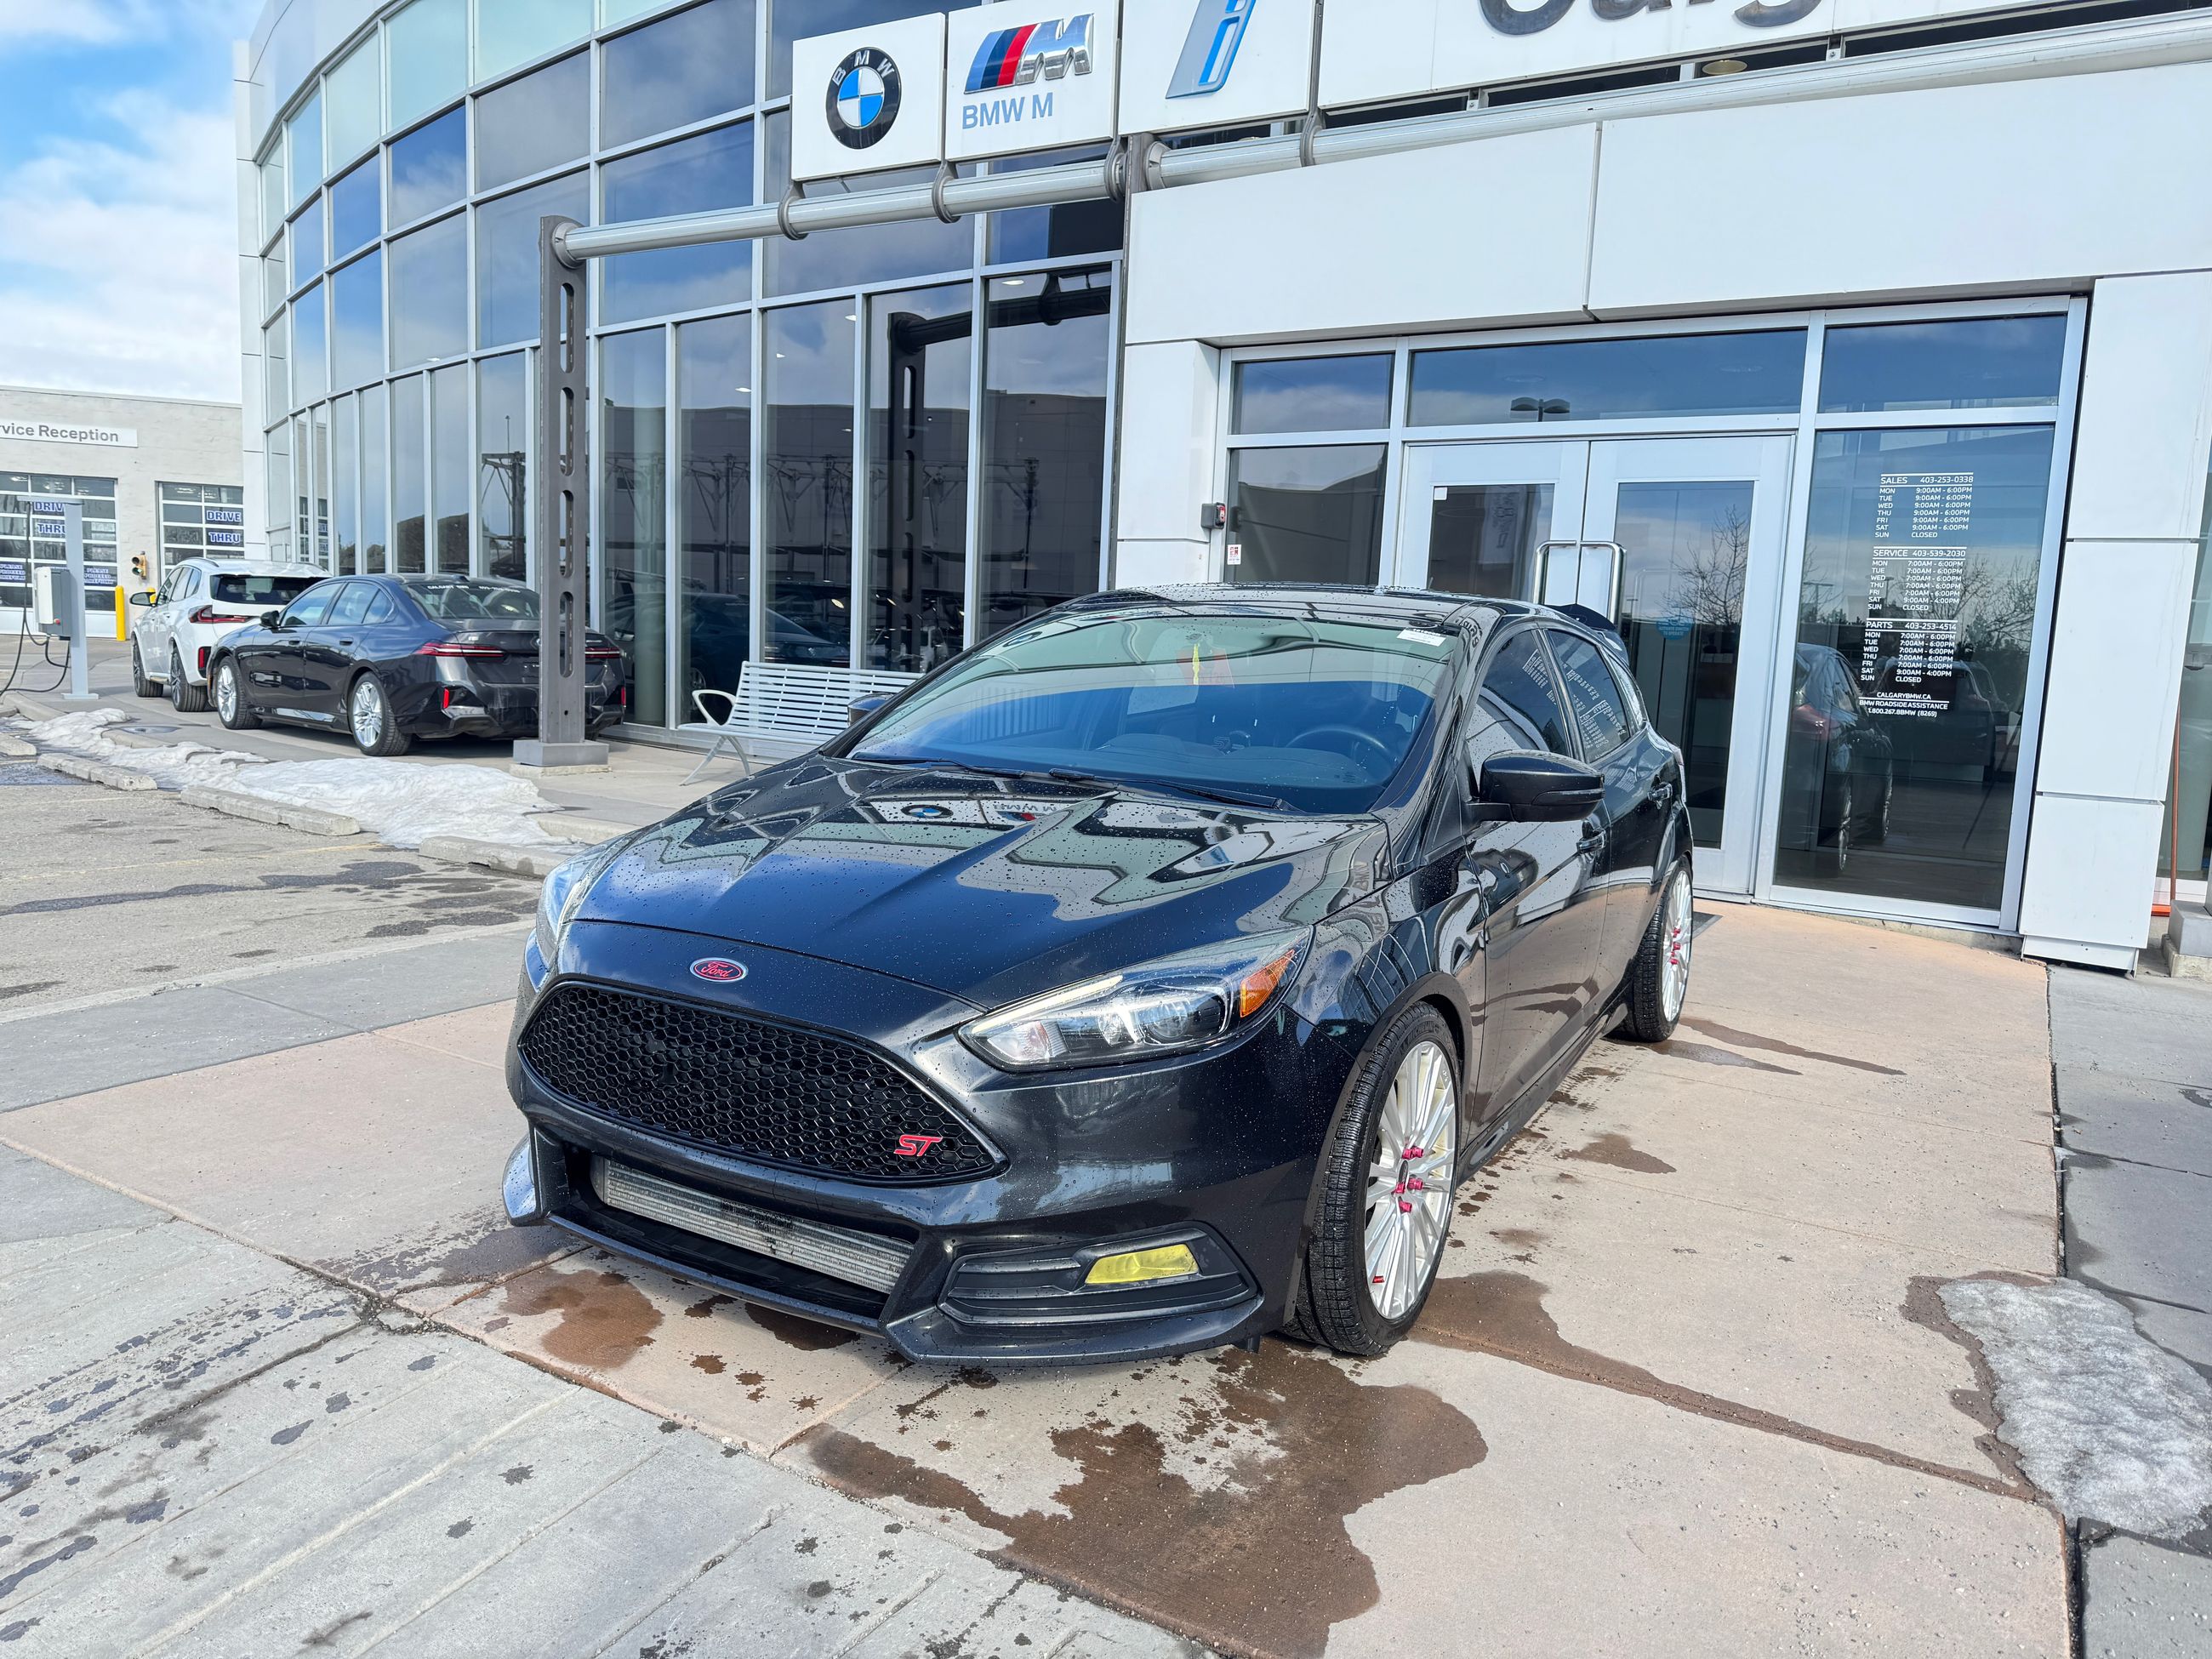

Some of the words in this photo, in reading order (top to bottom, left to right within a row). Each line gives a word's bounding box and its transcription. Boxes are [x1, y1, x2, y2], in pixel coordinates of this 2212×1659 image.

[831, 50, 894, 85] BMW
[961, 95, 1025, 129] BMW
[1031, 92, 1053, 119] M
[38, 425, 119, 442] Reception
[33, 502, 65, 511] DRIV
[207, 510, 242, 522] DRIVE
[208, 532, 241, 543] THRU
[1876, 692, 1931, 700] CALGARYBMW.CA
[700, 961, 733, 978] Ford
[893, 1134, 944, 1157] ST
